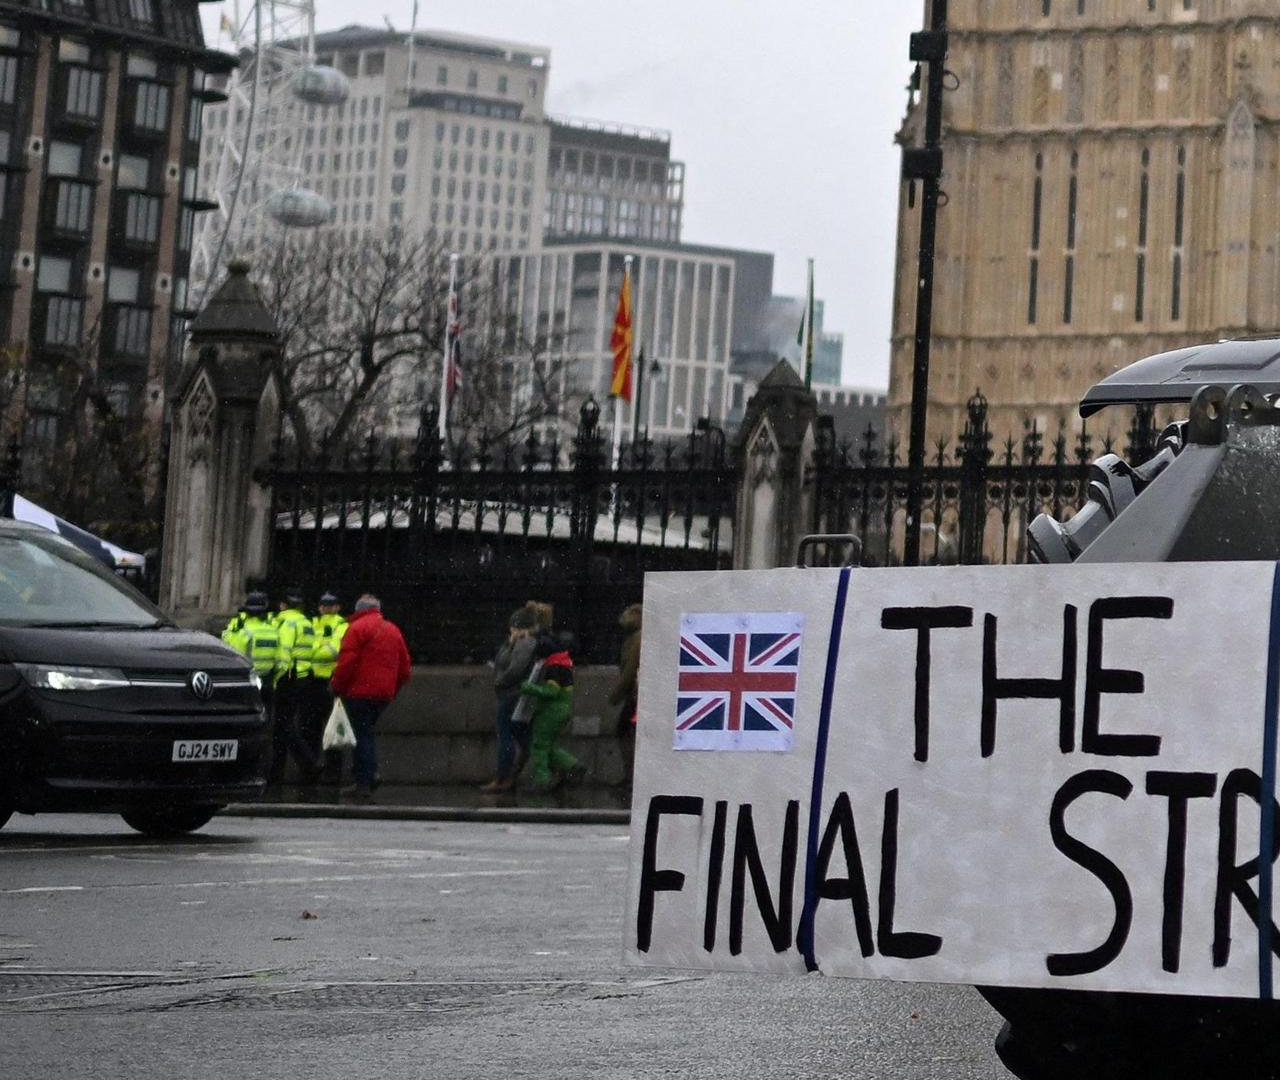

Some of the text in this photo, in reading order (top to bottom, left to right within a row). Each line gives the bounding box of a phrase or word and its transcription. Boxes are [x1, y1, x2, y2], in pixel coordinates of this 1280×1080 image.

[178, 743, 209, 759] GJ24
[881, 596, 1174, 762] THE
[637, 788, 943, 960] FINAL
